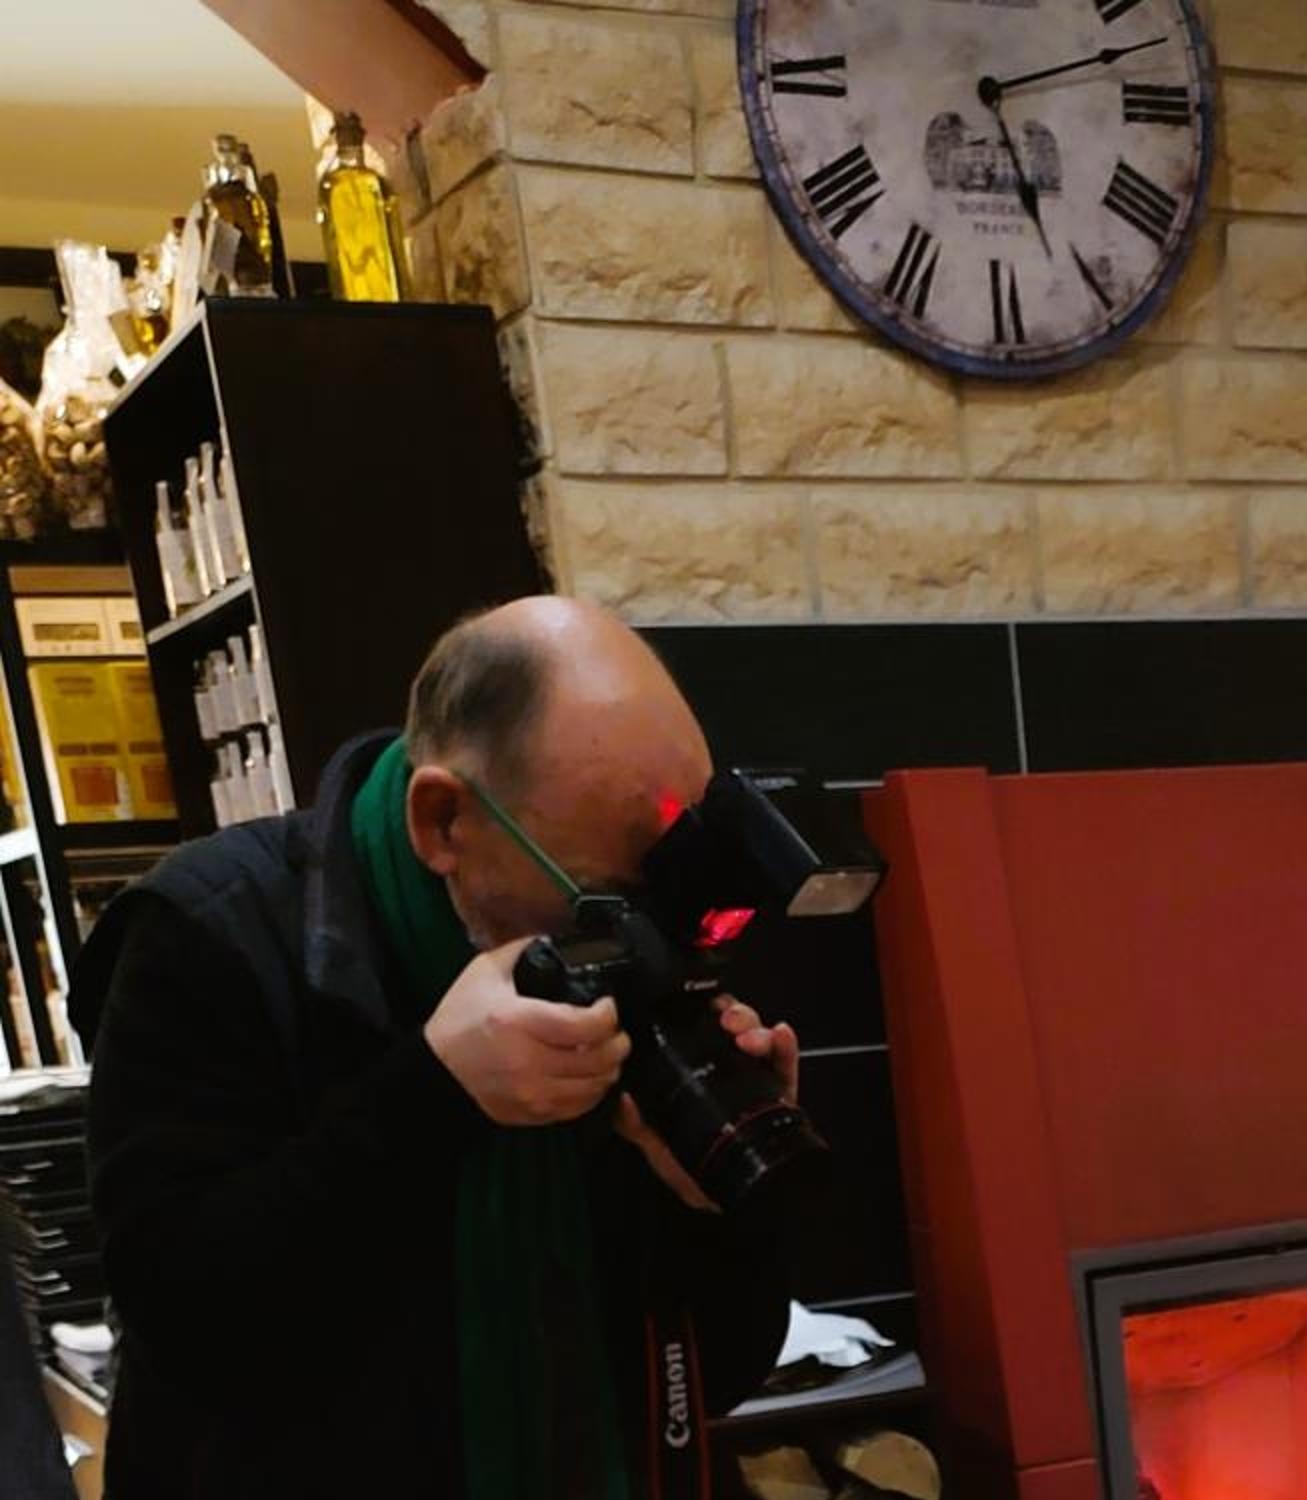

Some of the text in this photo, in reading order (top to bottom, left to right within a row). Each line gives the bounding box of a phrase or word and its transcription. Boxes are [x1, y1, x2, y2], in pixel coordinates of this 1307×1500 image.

[1121, 83, 1191, 126] III
[802, 144, 886, 241] VIII
[1102, 159, 1182, 247] IIII
[883, 223, 942, 319] VII
[665, 1343, 691, 1448] Canon
